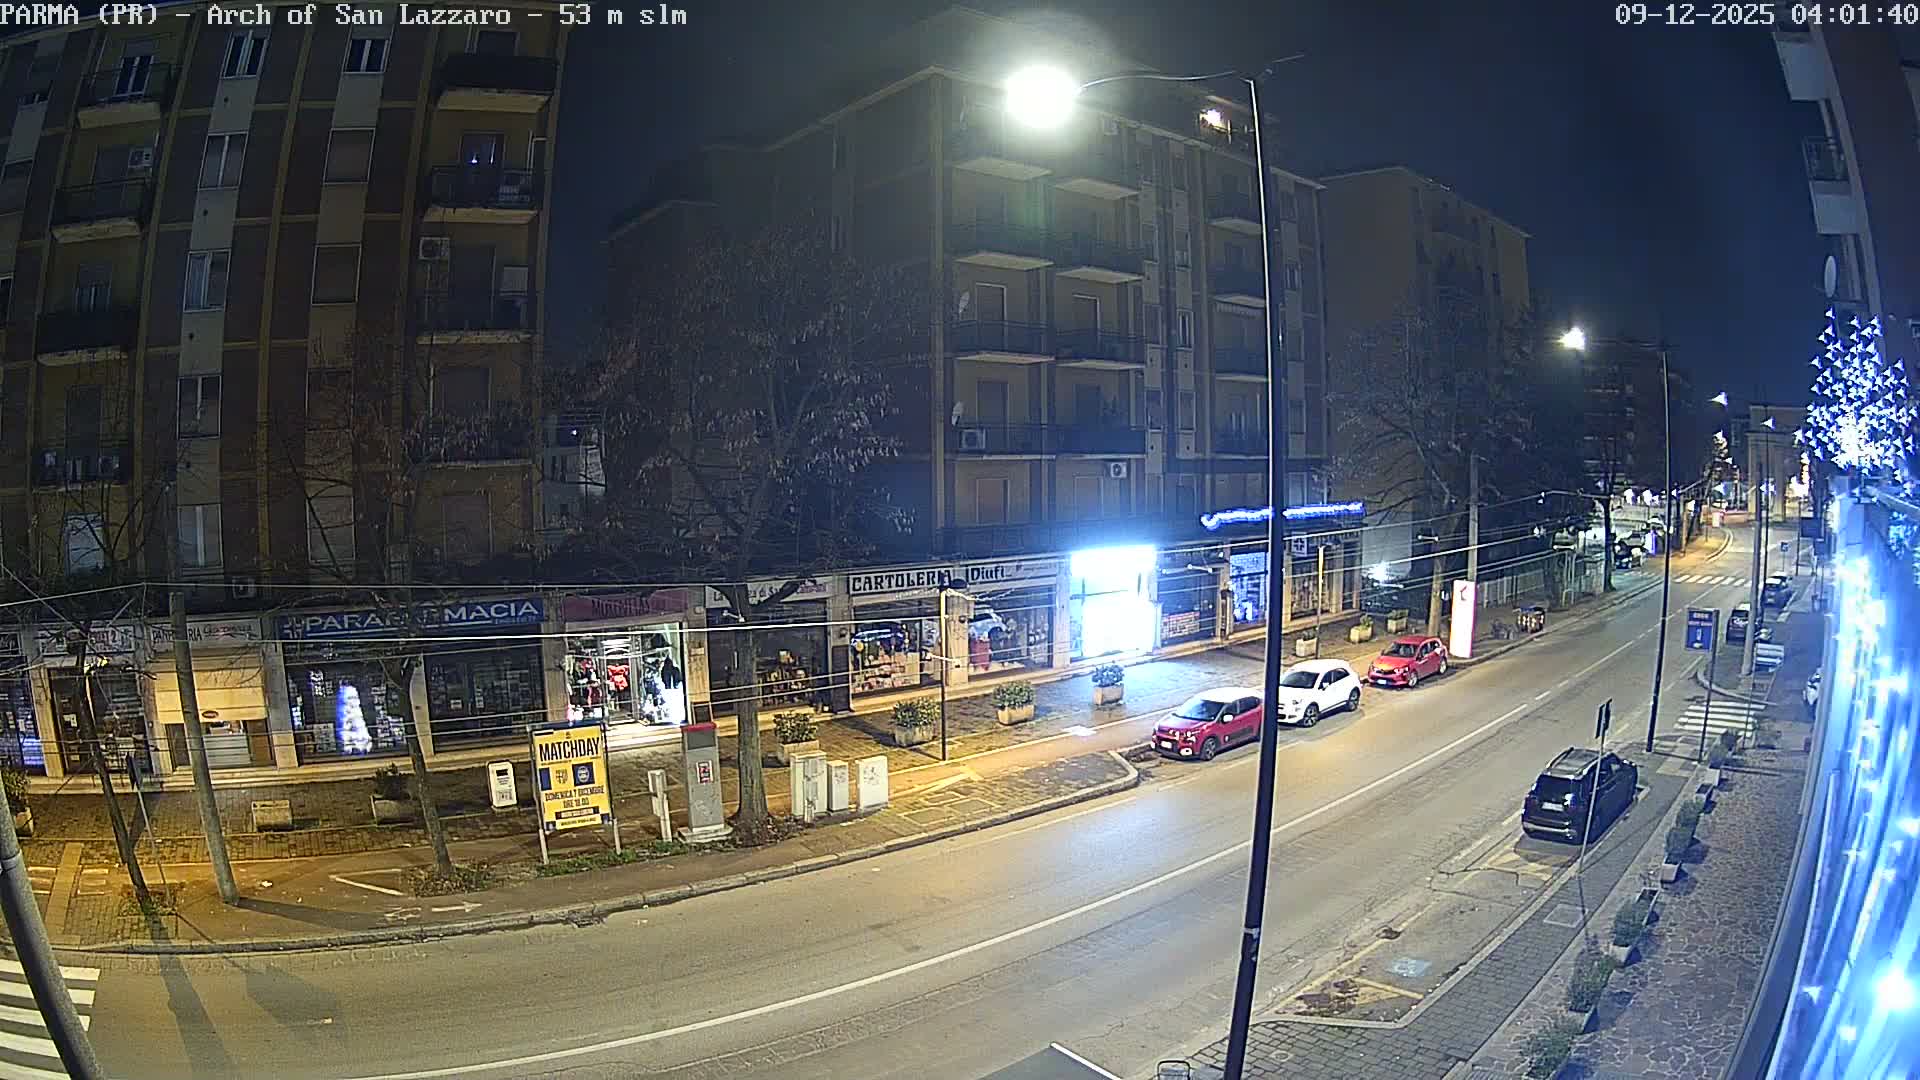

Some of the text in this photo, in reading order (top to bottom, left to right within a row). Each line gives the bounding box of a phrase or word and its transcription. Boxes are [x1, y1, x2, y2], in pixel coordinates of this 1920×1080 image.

[851, 569, 952, 593] CARTOLERIA
[305, 601, 538, 631] PARAFRMACIA
[538, 736, 600, 762] MATCHDAY
